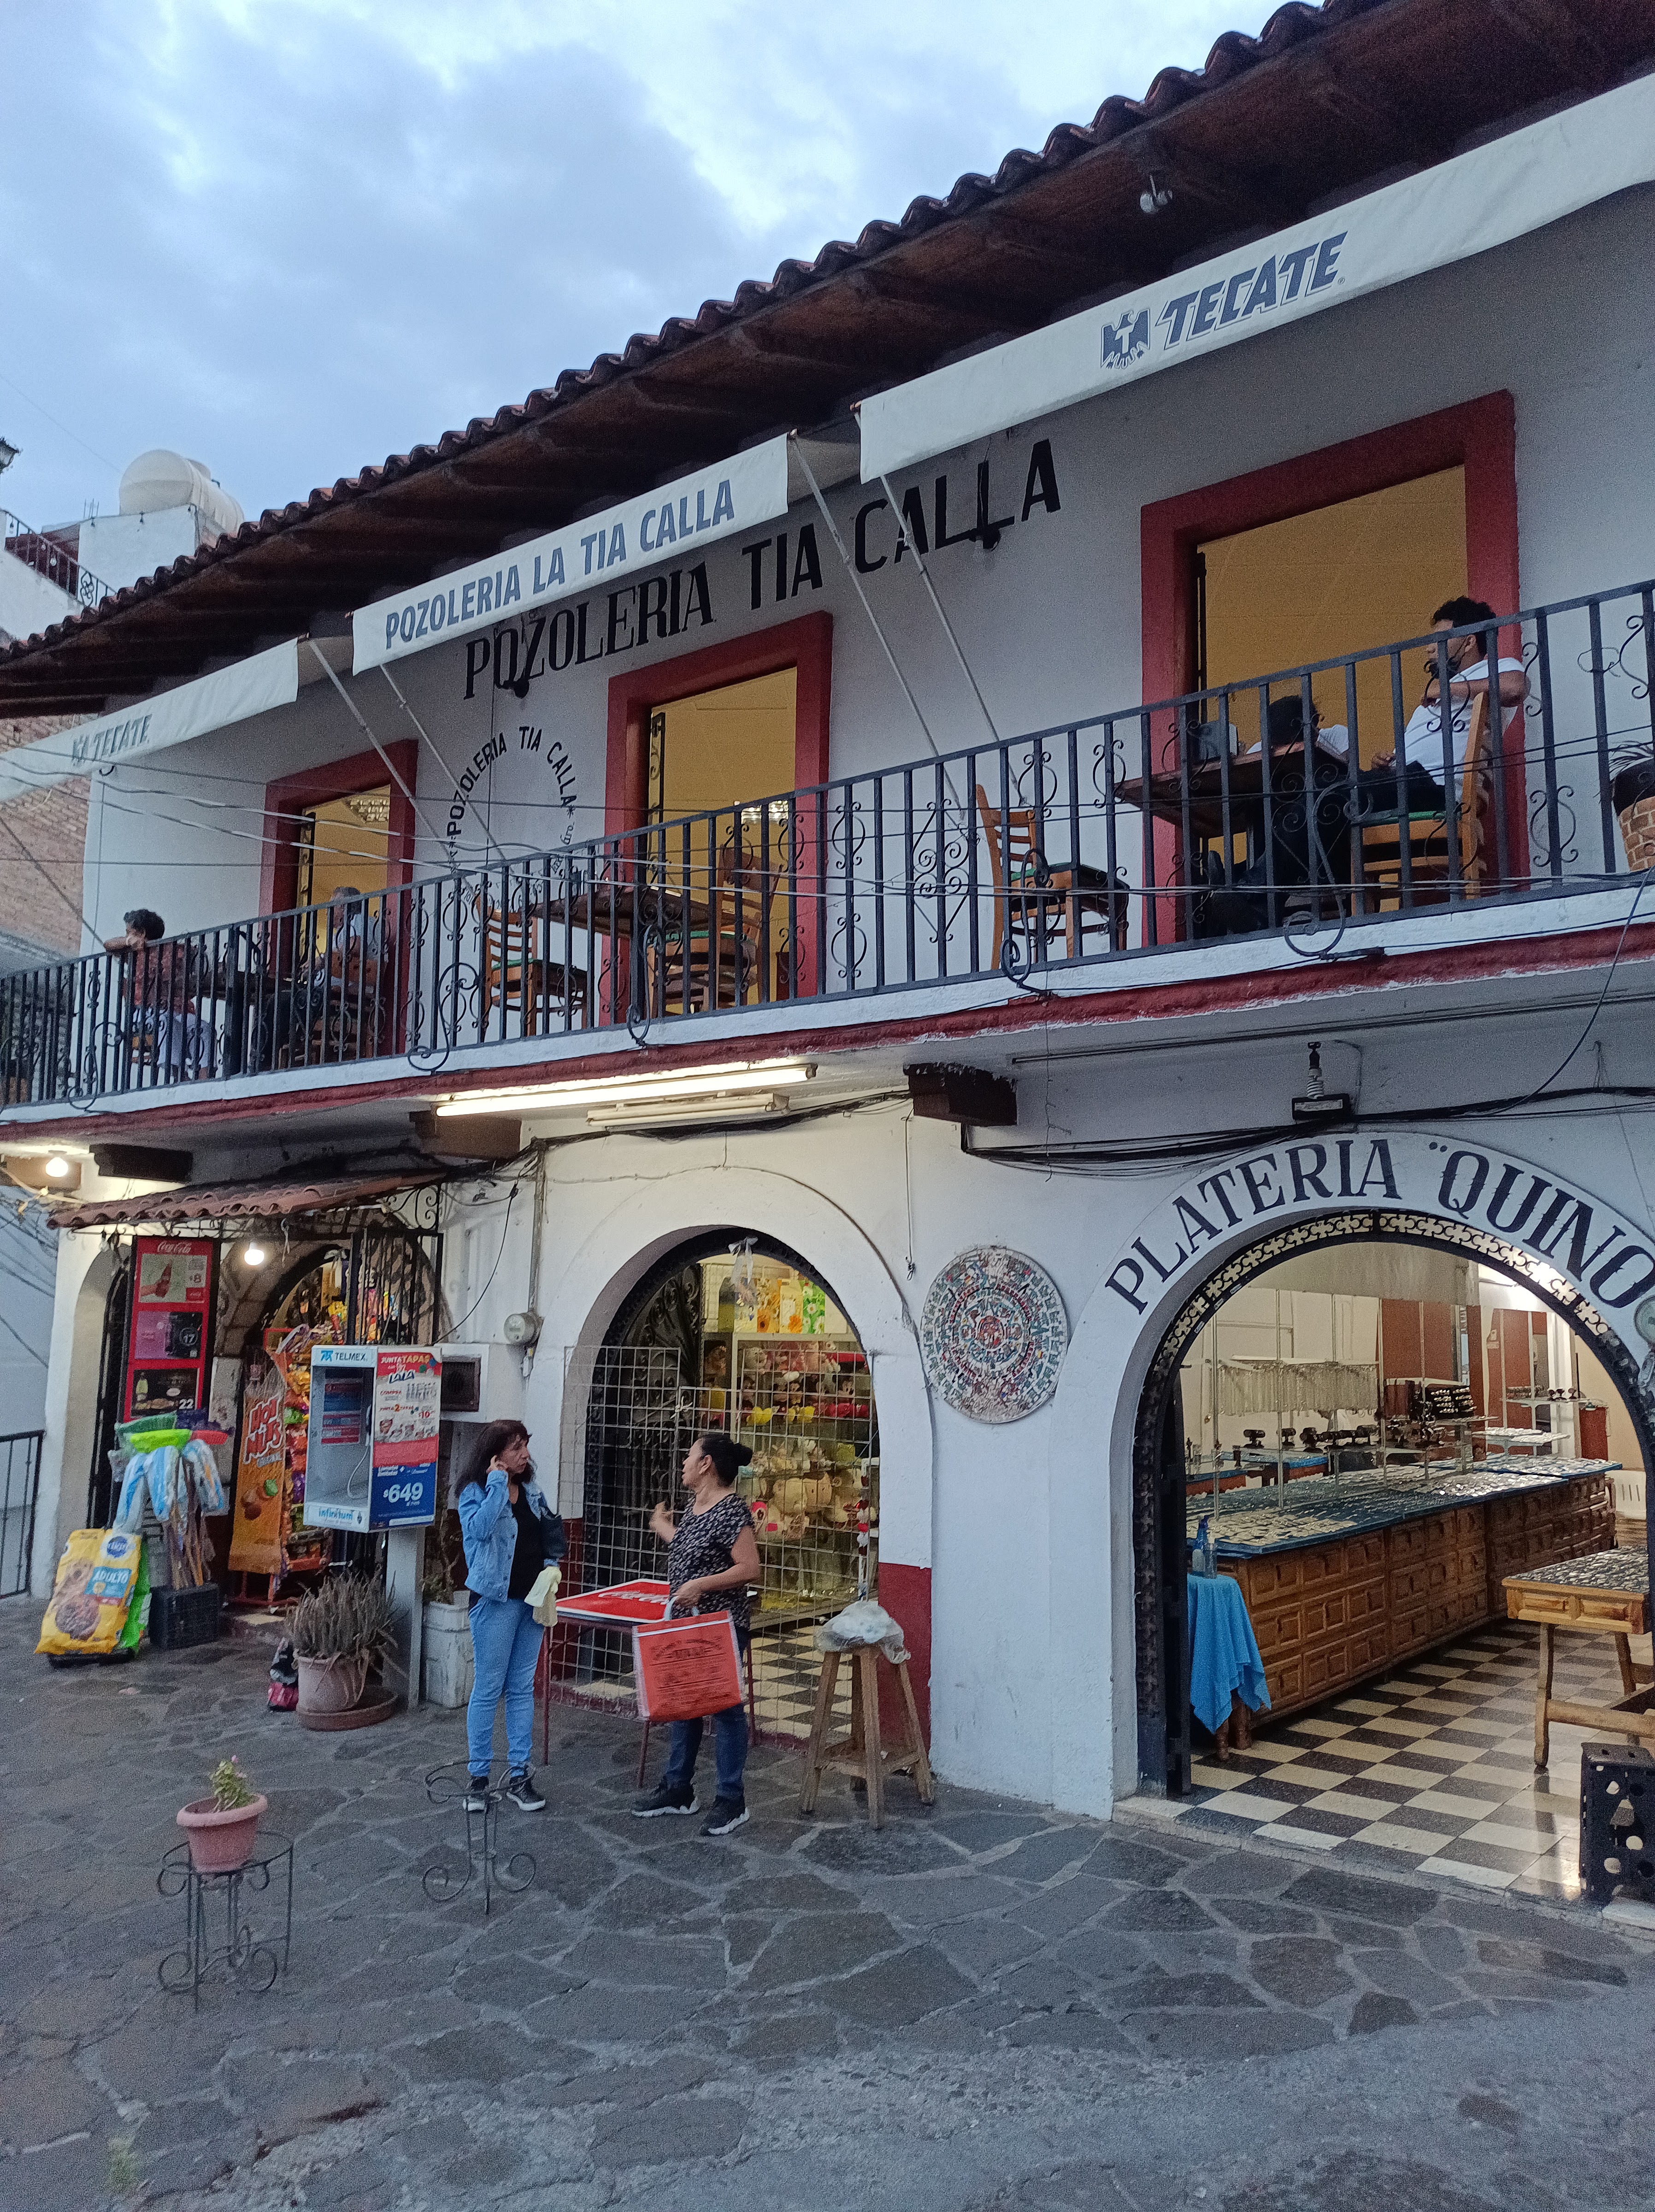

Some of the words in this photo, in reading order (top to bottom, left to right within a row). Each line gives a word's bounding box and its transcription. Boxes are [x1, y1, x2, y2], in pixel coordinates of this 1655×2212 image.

[1155, 231, 1348, 350] TECATE
[386, 564, 521, 650] POZOLERIA
[533, 547, 565, 595] LA
[581, 523, 626, 575] TIA
[640, 479, 734, 552] CALLA
[464, 560, 714, 700] POZOLERIA
[742, 523, 823, 611] TIA
[854, 439, 1061, 573] CALLA
[94, 714, 153, 761] TECATE
[447, 732, 507, 837] POZOLERIA
[519, 726, 542, 752] TIA
[547, 742, 577, 808] CALLA
[1105, 1139, 1402, 1315] PLATERIA
[335, 1352, 367, 1361] TELMEX
[179, 1398, 194, 1410] 22
[383, 1482, 423, 1503] $649
[93, 1570, 129, 1584] ADULTO
